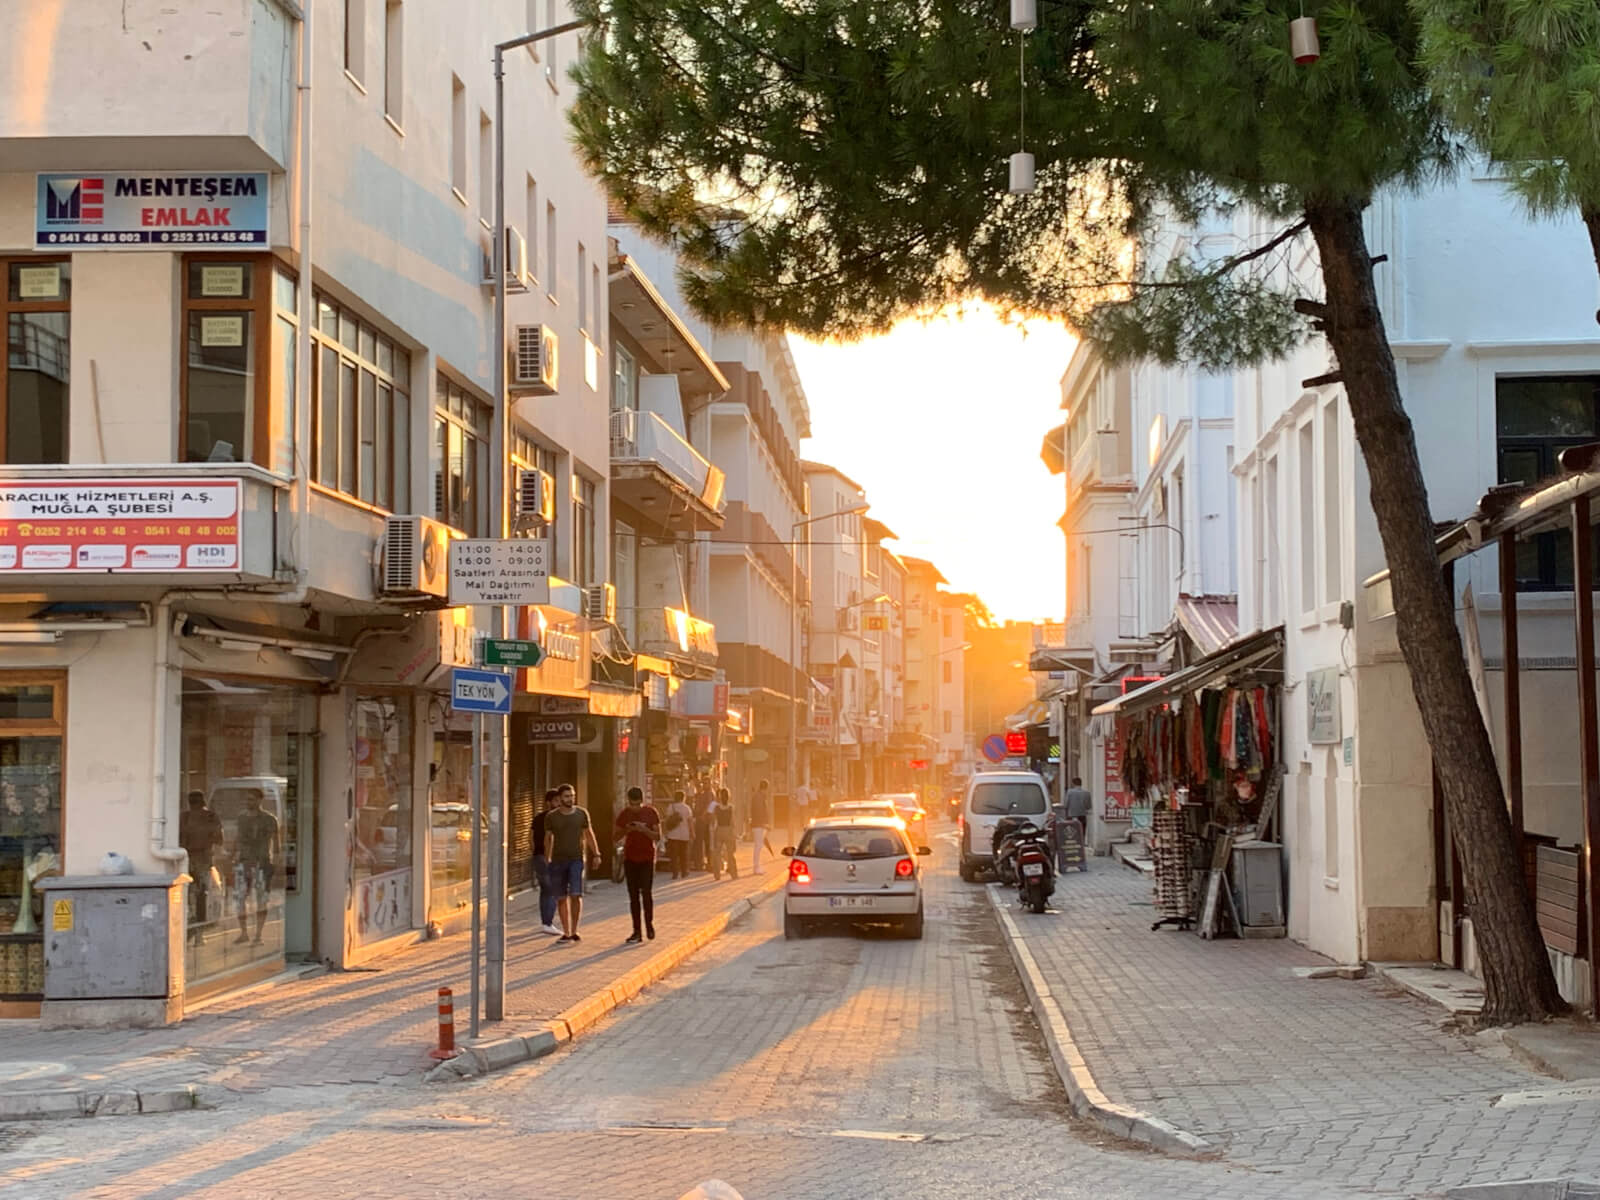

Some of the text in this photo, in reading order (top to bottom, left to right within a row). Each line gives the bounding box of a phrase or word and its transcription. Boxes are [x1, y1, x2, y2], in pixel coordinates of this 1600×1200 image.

[115, 178, 257, 201] MENTEŞEM
[142, 207, 231, 227] EMLAK
[49, 233, 57, 243] 0
[84, 233, 98, 243] 48
[102, 233, 116, 243] 48
[119, 233, 140, 243] 002
[161, 232, 254, 242] 0 252 214 45 48
[77, 490, 174, 501] HİZMETLERİ
[181, 492, 213, 503] A.Ş.
[32, 501, 173, 516] MUĞLA ŞUBESİ
[34, 526, 61, 536] 0252
[67, 526, 87, 536] 214
[93, 526, 106, 536] 45
[112, 526, 126, 536] 48
[144, 526, 170, 536] 0541
[177, 526, 191, 535] 48
[197, 526, 210, 535] 48
[216, 526, 236, 535] 002
[197, 547, 225, 557] HDI
[509, 546, 542, 554] 14:00
[458, 557, 491, 565] 16:00
[508, 557, 542, 565] 09:00
[454, 569, 545, 577] Saatleri Arasında
[465, 580, 535, 590] Mal Dağıtımı
[479, 592, 522, 600] Yasaktır
[458, 684, 495, 698] TEK YÖN
[532, 721, 574, 732] bravo
